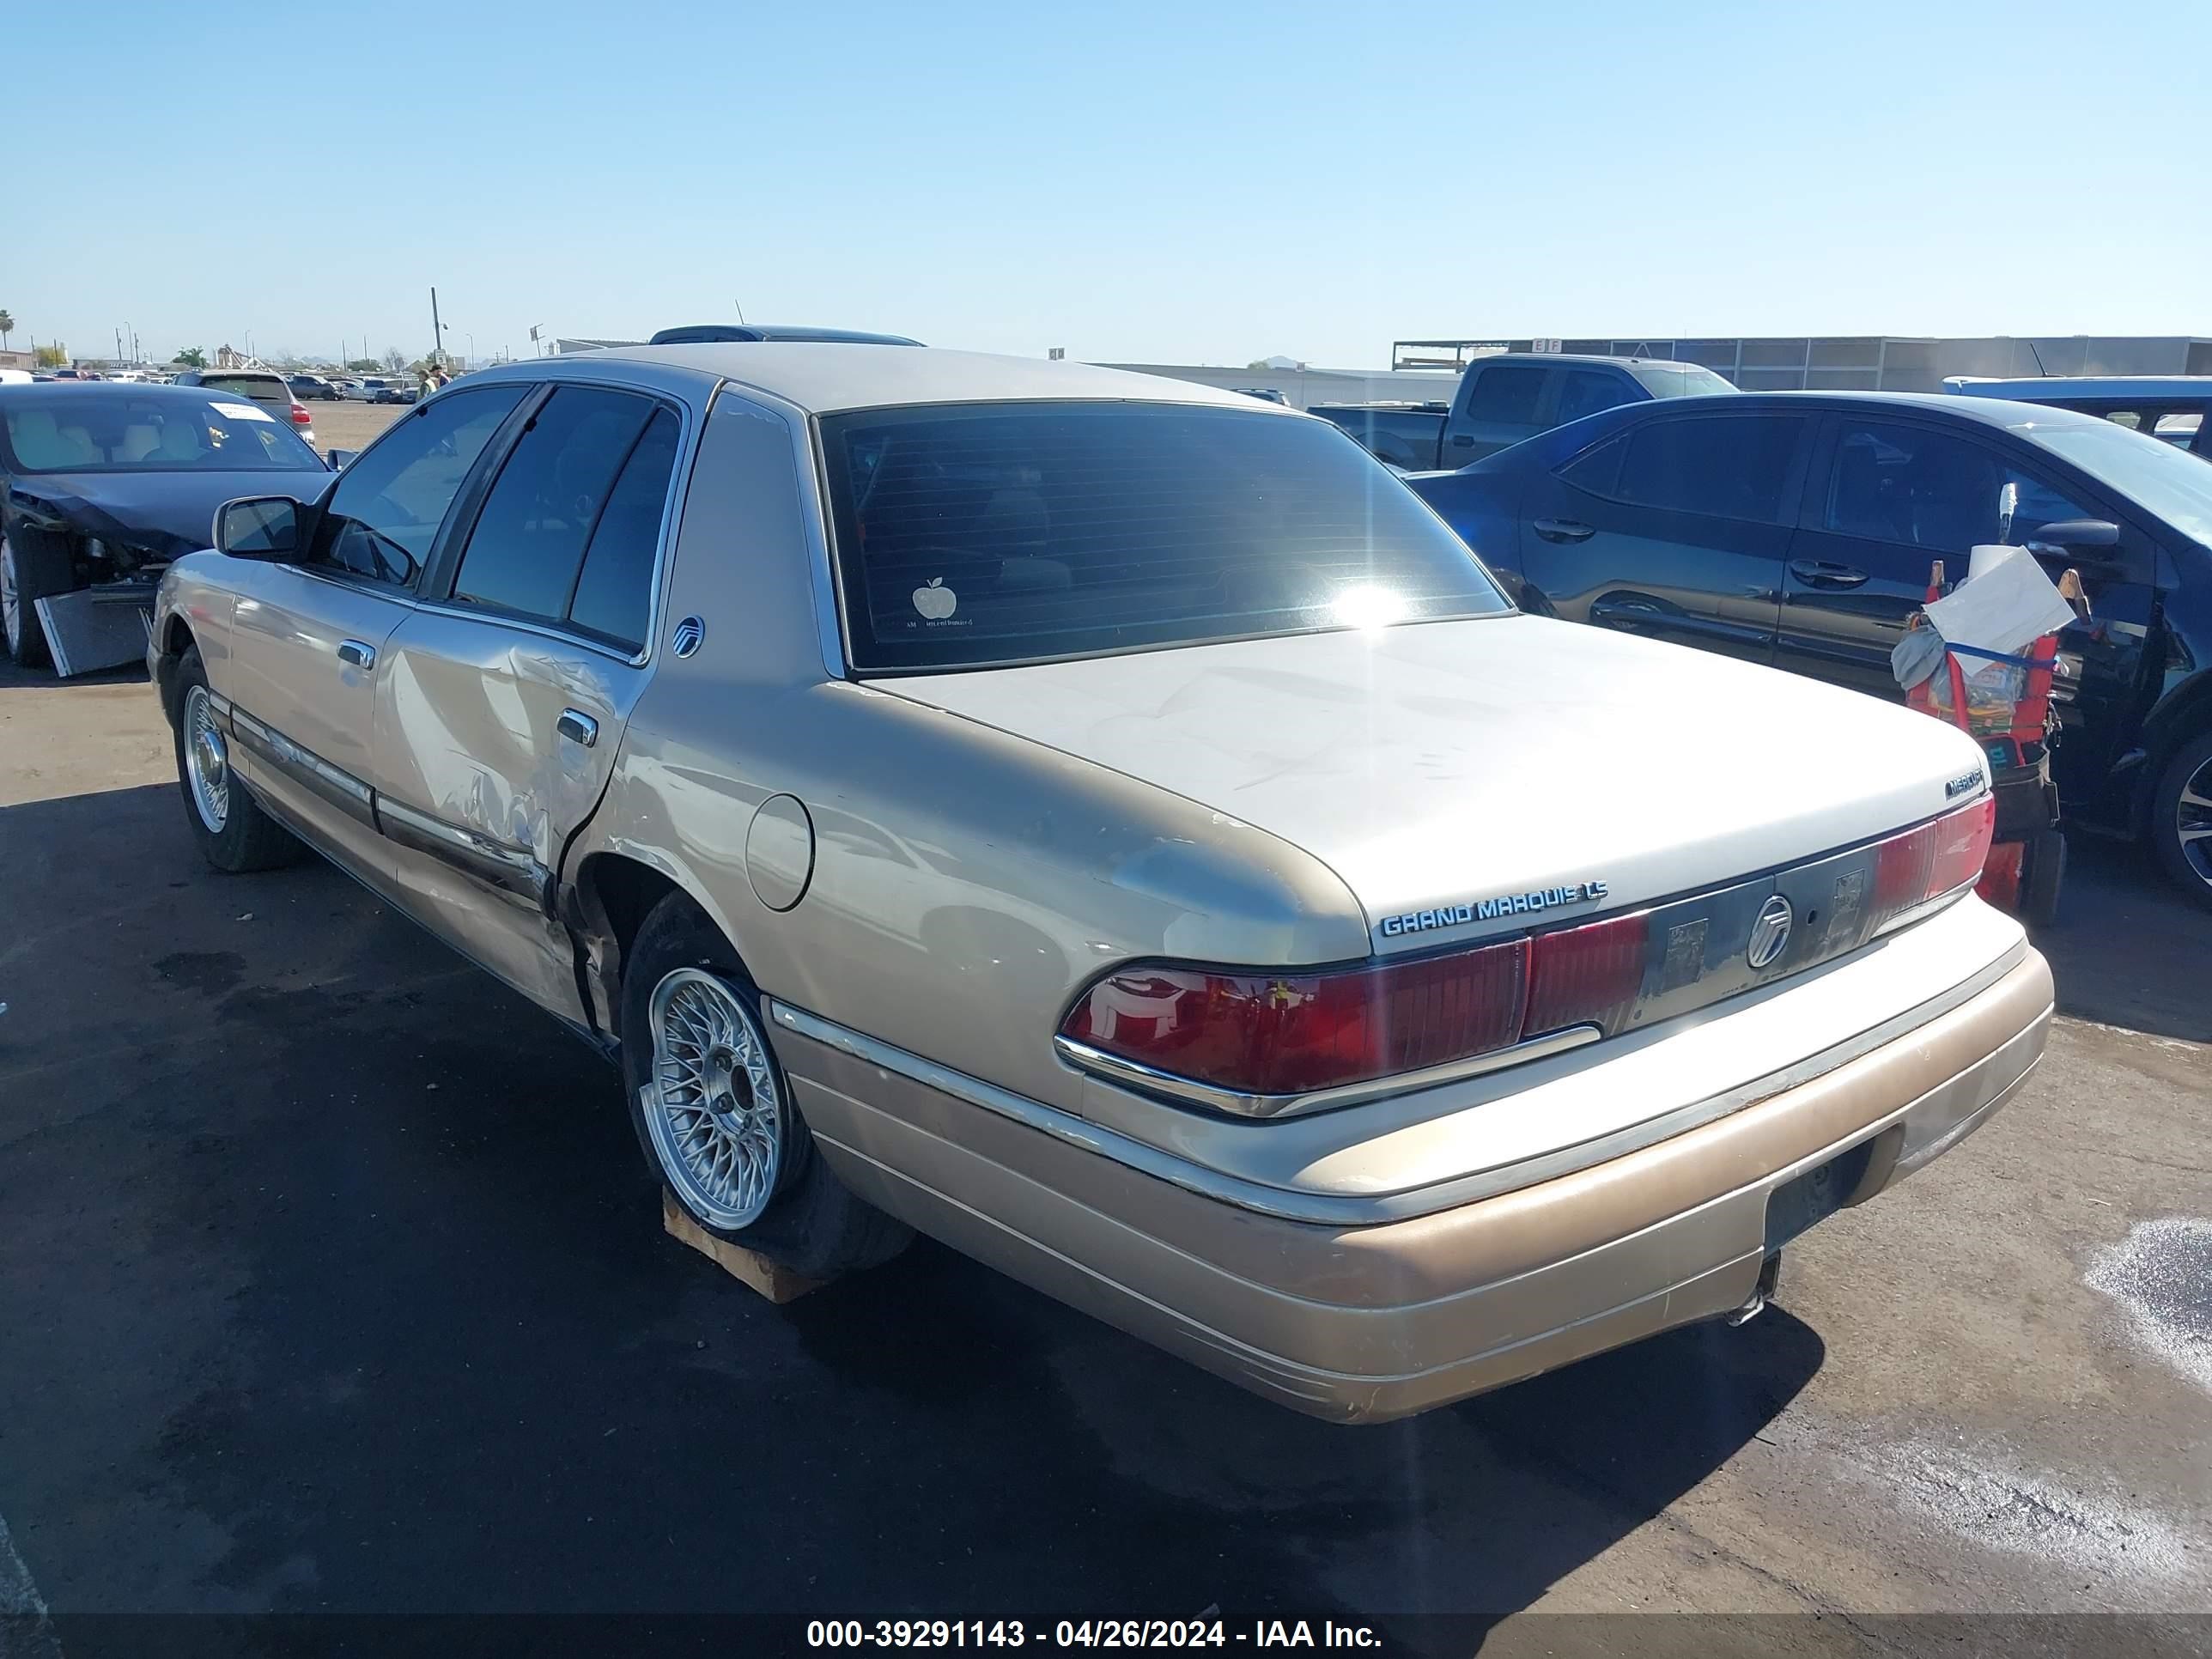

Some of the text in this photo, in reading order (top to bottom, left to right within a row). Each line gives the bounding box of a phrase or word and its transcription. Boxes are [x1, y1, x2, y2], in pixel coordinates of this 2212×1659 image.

[1382, 880, 1608, 936] GRAND MARQUIS LS
